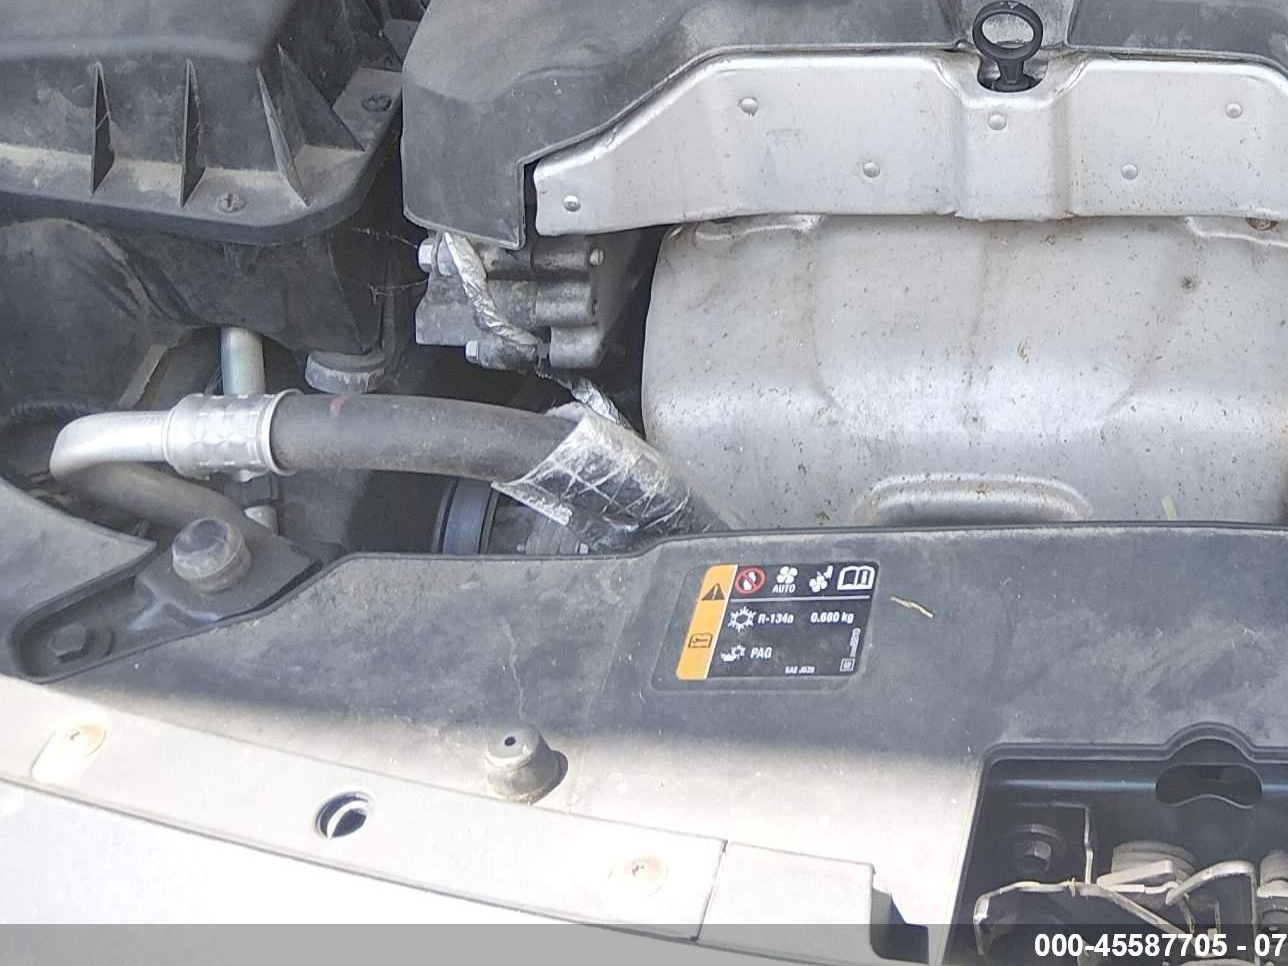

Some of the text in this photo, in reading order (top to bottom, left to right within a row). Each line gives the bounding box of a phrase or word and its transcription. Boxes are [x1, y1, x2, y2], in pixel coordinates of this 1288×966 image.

[772, 584, 796, 593] AUTO
[757, 612, 795, 624] R-134a
[841, 611, 855, 624] kg
[750, 647, 773, 659] PAG
